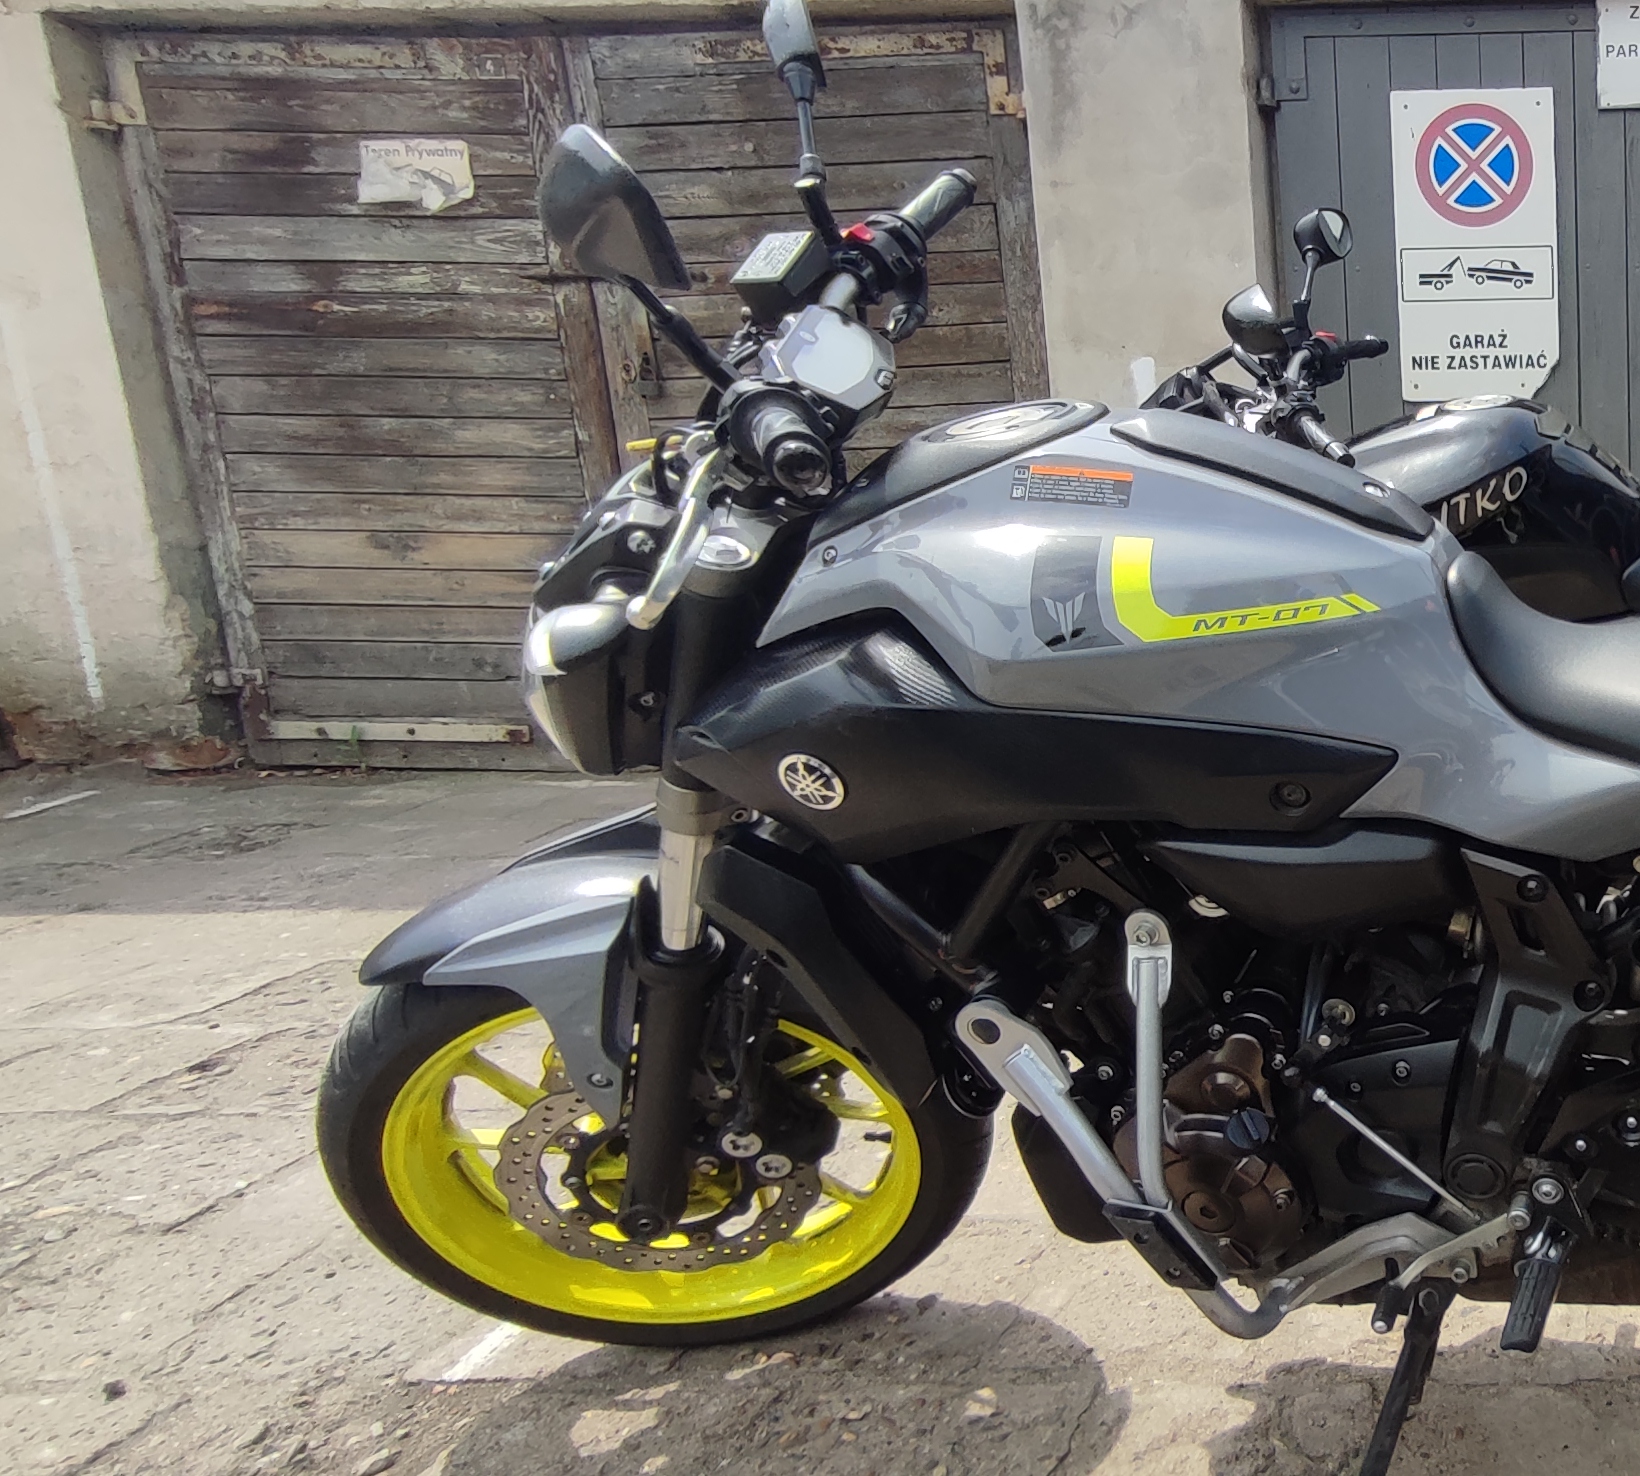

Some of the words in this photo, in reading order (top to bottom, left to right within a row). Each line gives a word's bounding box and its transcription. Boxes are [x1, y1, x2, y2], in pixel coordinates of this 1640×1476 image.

[1449, 328, 1508, 349] GARAŻ
[1411, 355, 1441, 370] NIE
[1446, 349, 1548, 370] ZASTAWIAĆ
[1192, 603, 1330, 632] MT-07
